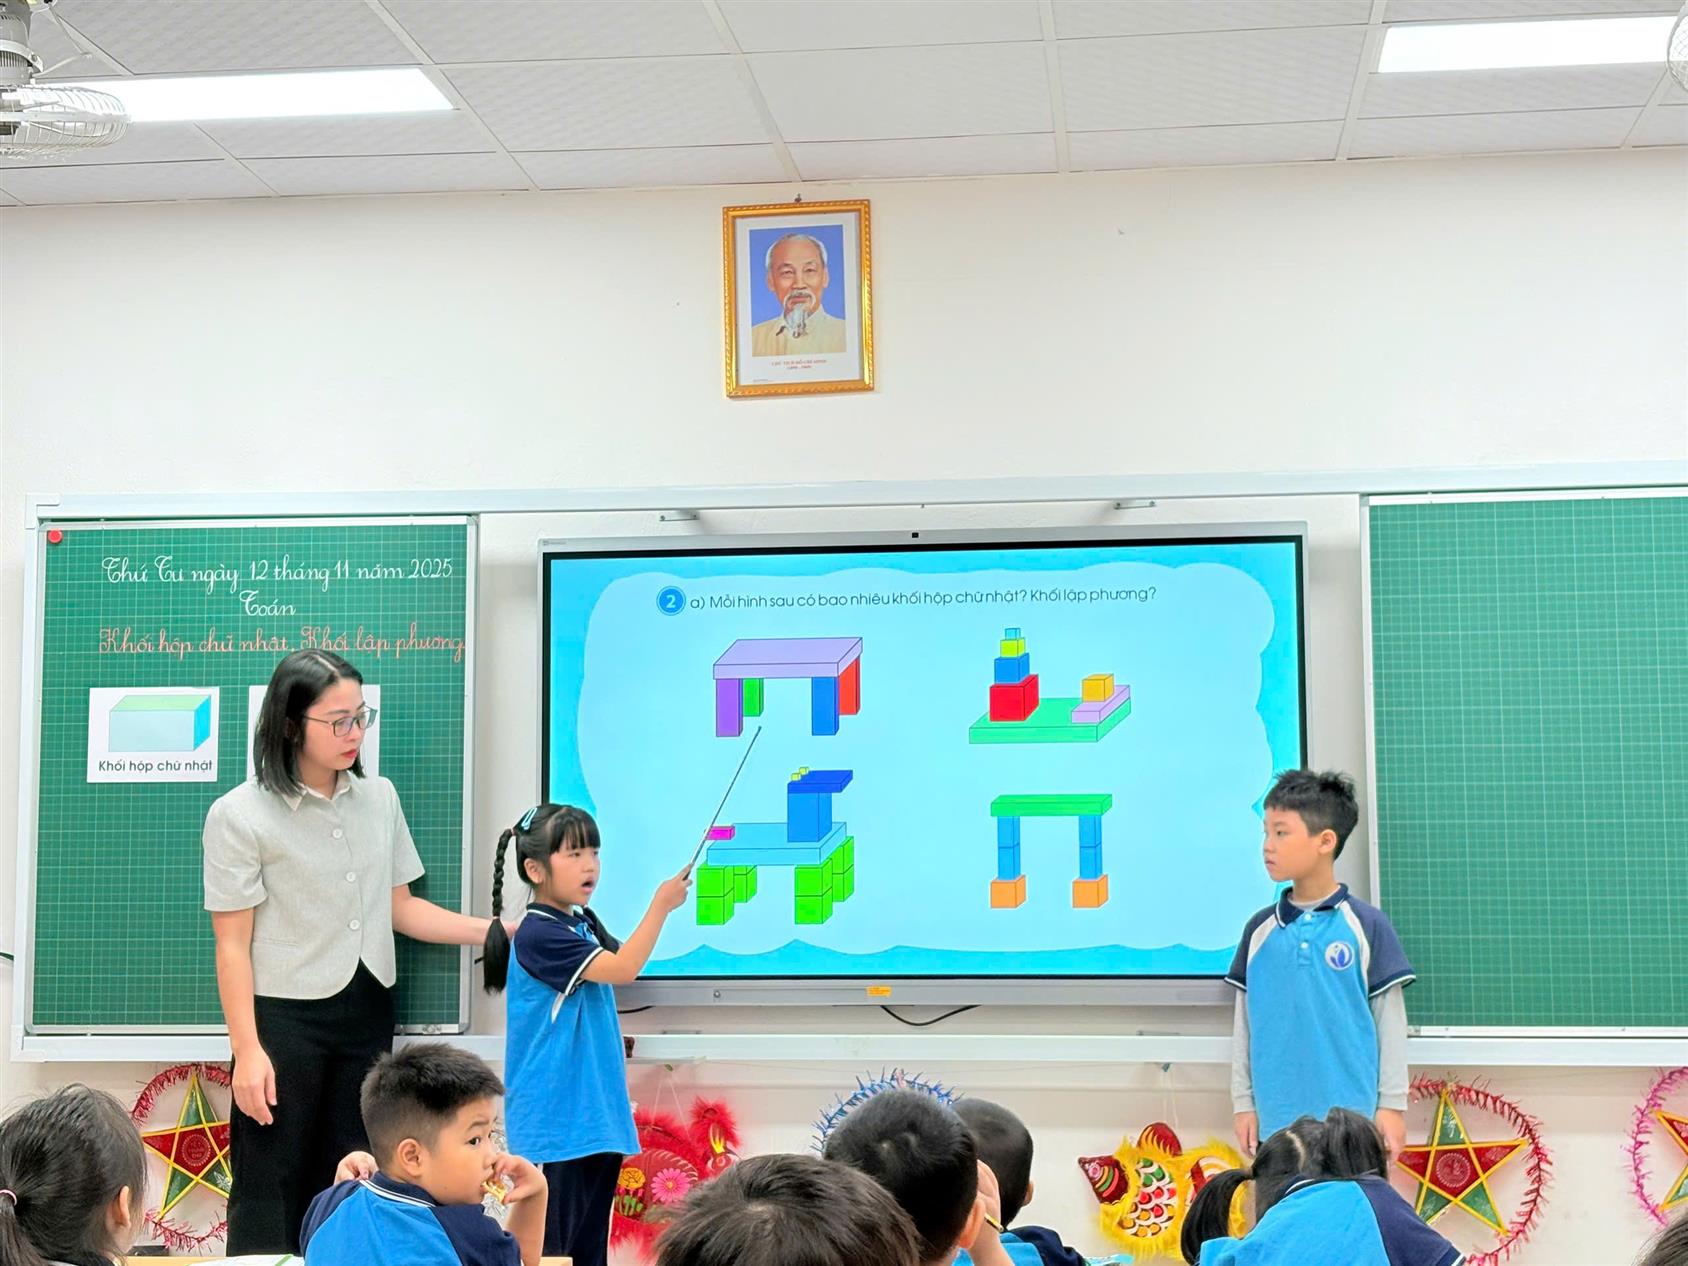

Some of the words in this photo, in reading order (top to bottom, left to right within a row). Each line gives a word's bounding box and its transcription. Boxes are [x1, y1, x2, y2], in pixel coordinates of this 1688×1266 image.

[101, 557, 148, 583] Thứ
[191, 564, 239, 595] ngày
[250, 559, 269, 581] 12
[273, 554, 330, 592] tháng
[335, 559, 350, 579] 11
[356, 564, 405, 579] năm
[408, 558, 453, 579] 2025
[239, 589, 296, 616] Toán
[665, 594, 676, 609] 2
[690, 596, 705, 610] a)
[738, 594, 767, 608] hình
[770, 596, 794, 608] sau
[796, 593, 816, 607] có
[819, 594, 848, 607] bao
[850, 592, 890, 606] nhiêu
[892, 591, 921, 605] khối
[924, 591, 953, 606] hộp
[955, 591, 984, 604] chữ
[986, 589, 1027, 603] nhật?
[1030, 587, 1061, 602] Khối
[1063, 588, 1088, 604] lập
[1090, 586, 1157, 603] phương?
[99, 626, 154, 654] Khối
[198, 626, 233, 653] chữ
[98, 759, 126, 772] Khối
[184, 760, 212, 773] nhật
